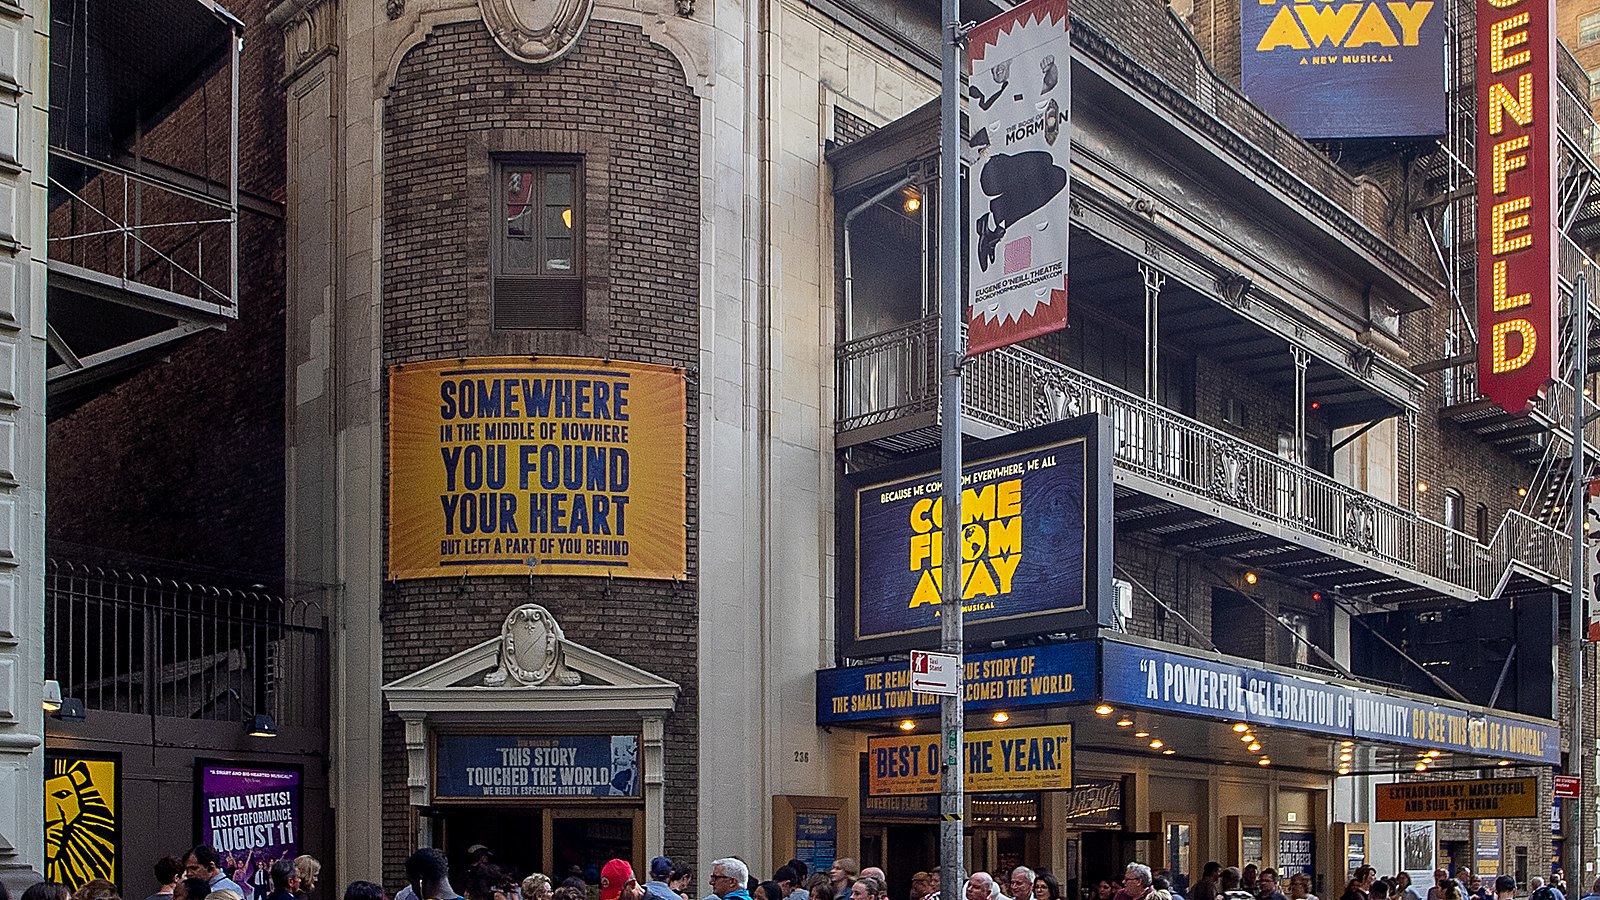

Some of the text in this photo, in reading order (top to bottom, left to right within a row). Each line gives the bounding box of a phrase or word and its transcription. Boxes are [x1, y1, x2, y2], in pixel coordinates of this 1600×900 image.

[1256, 1, 1434, 51] AWAY
[1312, 56, 1338, 64] NEW
[1342, 54, 1393, 64] MUSICAL
[975, 262, 1062, 296] EUGENE O'NEILL THEATRE
[440, 378, 630, 421] SOMEWHERE
[440, 422, 629, 443] IN THE MIDDLE OF NOWHERE
[440, 444, 630, 492] YOU FOUND
[881, 487, 912, 504] BECAUSE
[913, 484, 924, 496] WE
[926, 481, 942, 494] COM
[973, 462, 1025, 483] EVERYWHERE,
[1027, 460, 1039, 470] WE
[1041, 456, 1056, 468] ALL
[440, 493, 630, 535] YOUR HEART
[441, 538, 629, 556] BUT LEFT A PART OF YOU BEHIND
[864, 673, 882, 691] THE
[963, 664, 979, 680] RUE
[983, 658, 1018, 679] STORY
[1020, 656, 1036, 675] OF
[832, 696, 849, 714] THE
[852, 692, 882, 712] SMALL
[885, 690, 913, 708] TOWN
[963, 680, 1004, 701] COMED
[1007, 678, 1028, 697] THE
[1031, 674, 1075, 695] WORLD.
[1140, 659, 1158, 700] "A
[1164, 663, 1245, 714] POWERFUL
[1249, 678, 1333, 727] CELEBRATION
[1337, 696, 1352, 729] OF
[1355, 698, 1410, 738] HUMANITY.
[1412, 708, 1425, 740] GO
[1428, 710, 1445, 743] SEE
[1448, 715, 1467, 746] THIS
[1469, 720, 1488, 749] GEM
[1490, 723, 1500, 750] OF
[1502, 725, 1507, 750] A
[534, 748, 577, 766] STORY
[794, 751, 809, 763] 236
[871, 743, 921, 778] "BEST
[927, 743, 940, 775] O
[963, 740, 993, 774] THE
[1000, 736, 1068, 773] YEAR!"
[466, 767, 611, 786] TOUCHED THE WORLD.
[1468, 782, 1526, 796] MASTERFUL
[208, 792, 291, 813] FINAL WEEKS!
[495, 787, 511, 795] NEED
[521, 787, 557, 795] ESPECIALLY
[558, 787, 576, 795] RIGHT
[210, 808, 292, 829] LAST PERFORMANCE
[1405, 800, 1423, 812] AND
[212, 822, 294, 852] AUGUST 11
